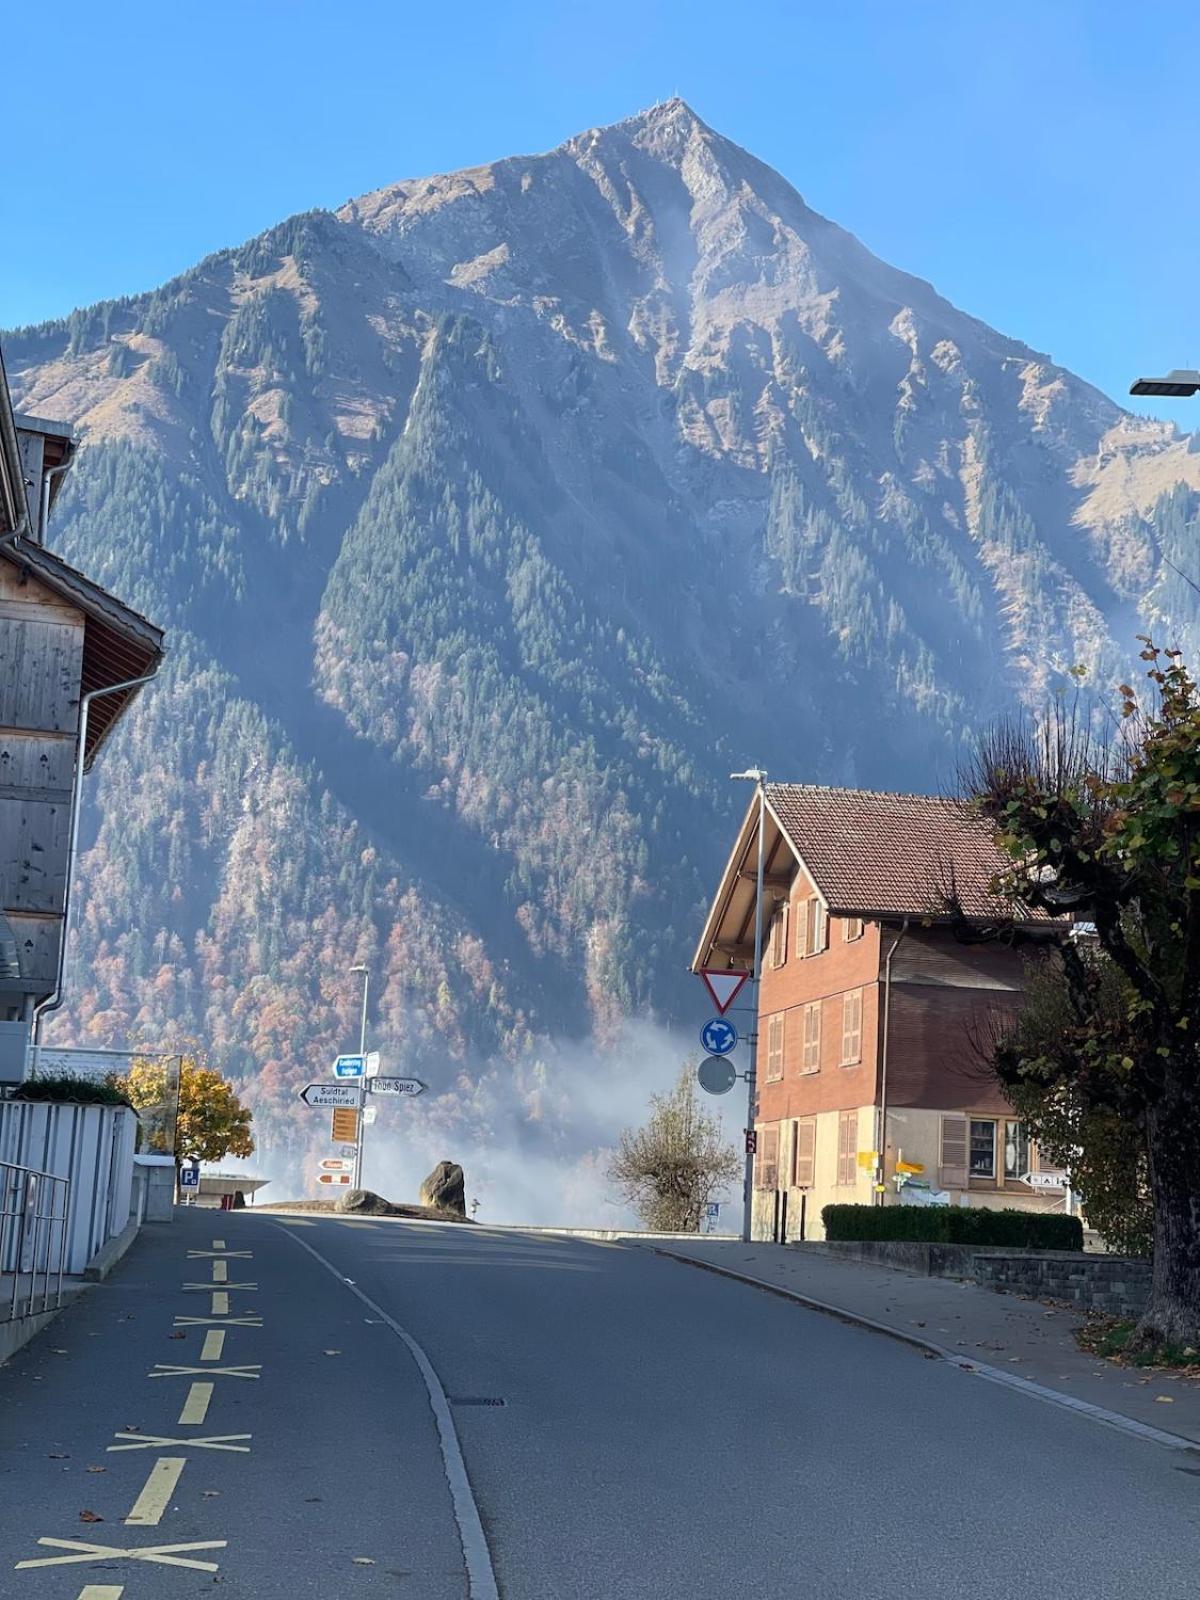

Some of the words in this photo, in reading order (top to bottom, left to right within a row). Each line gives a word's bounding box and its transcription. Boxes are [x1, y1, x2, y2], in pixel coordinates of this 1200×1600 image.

[321, 1087, 348, 1095] Suldtal
[394, 1081, 414, 1092] Spiez
[313, 1096, 355, 1105] Aeschiried
[185, 1170, 194, 1184] P
